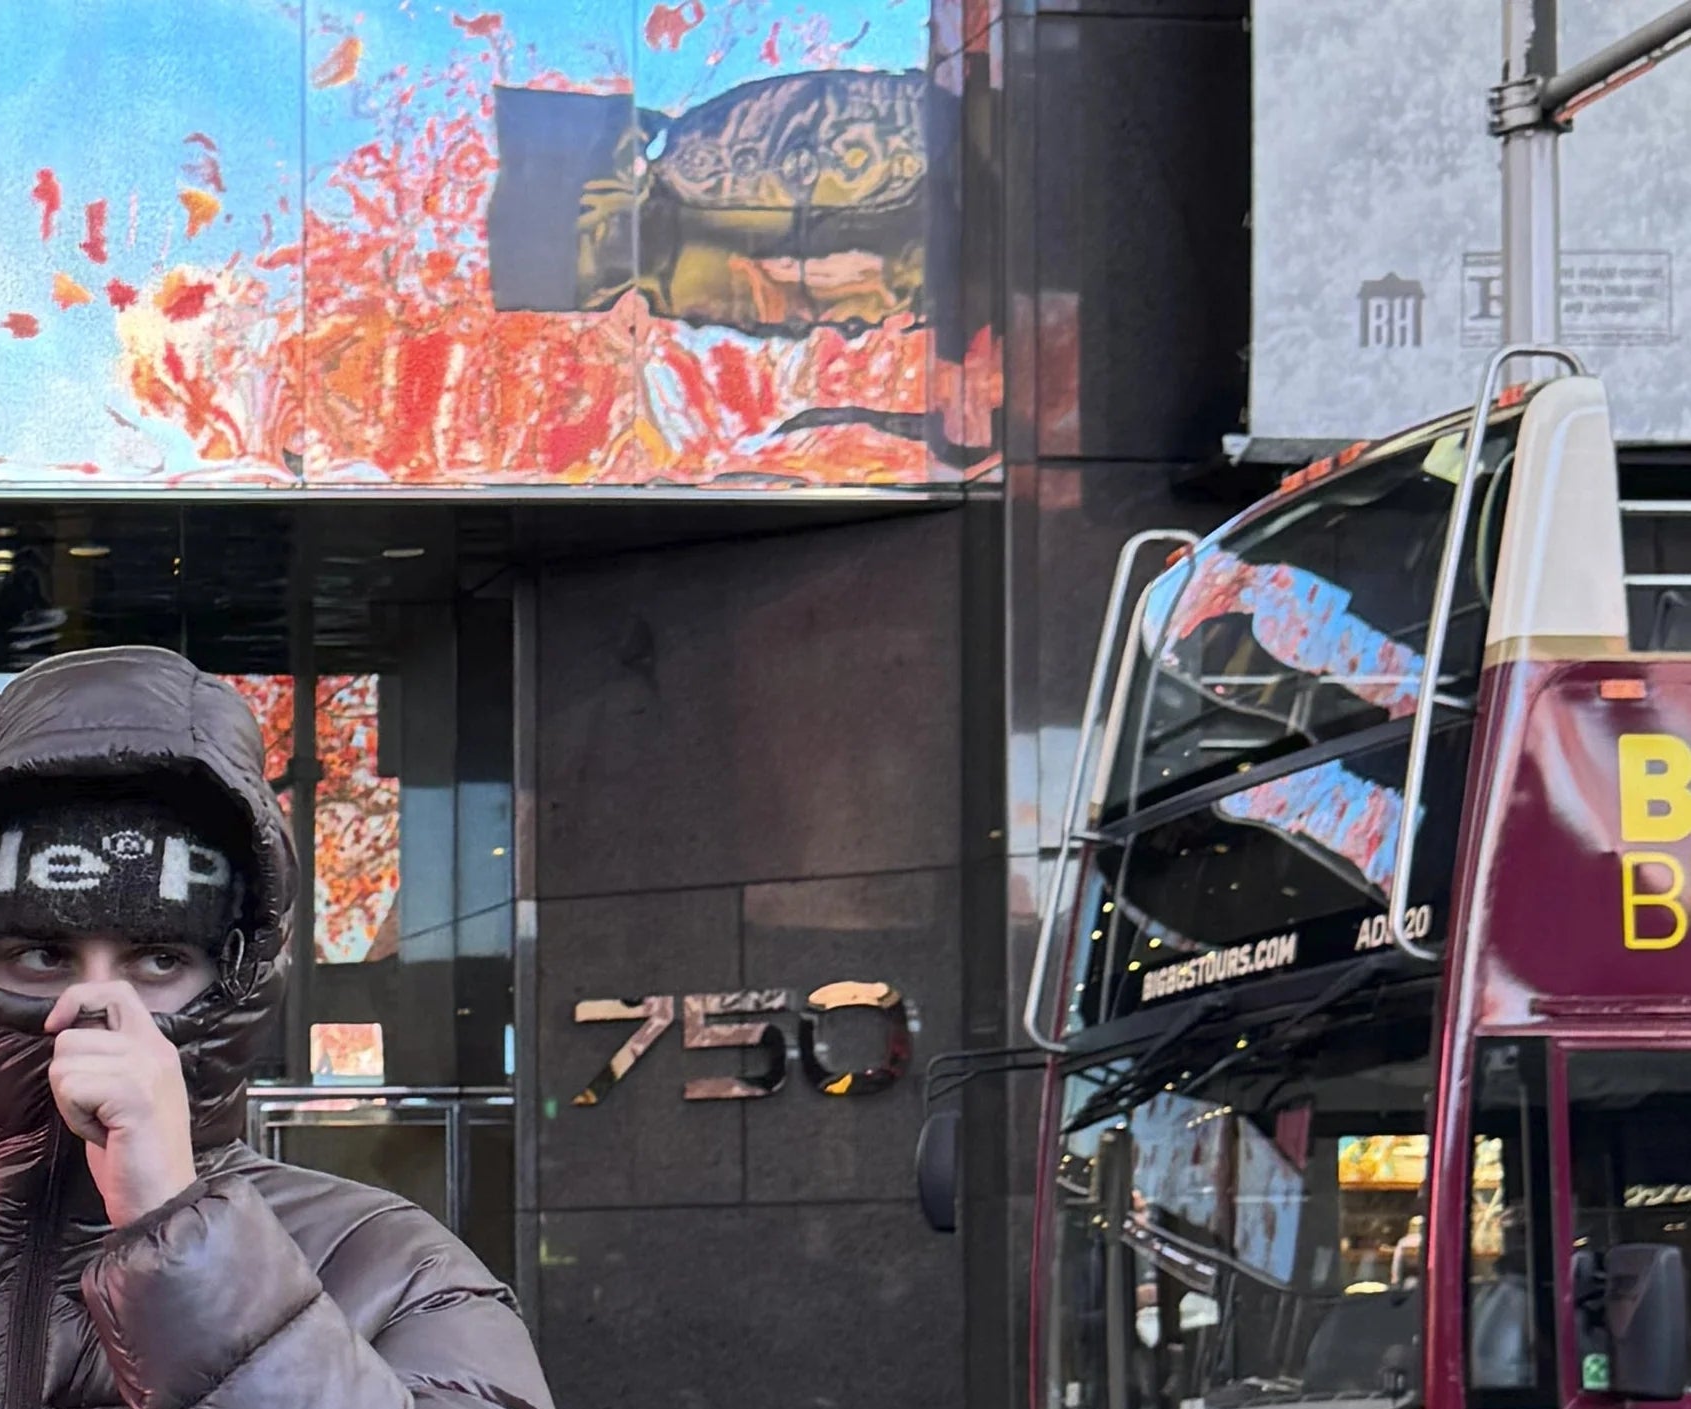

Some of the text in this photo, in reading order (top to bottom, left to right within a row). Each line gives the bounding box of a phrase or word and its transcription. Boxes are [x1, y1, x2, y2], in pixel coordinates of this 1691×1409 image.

[1141, 904, 1432, 1002] BIGBUSTOURS.COM AD20
[571, 980, 909, 1105] 750
